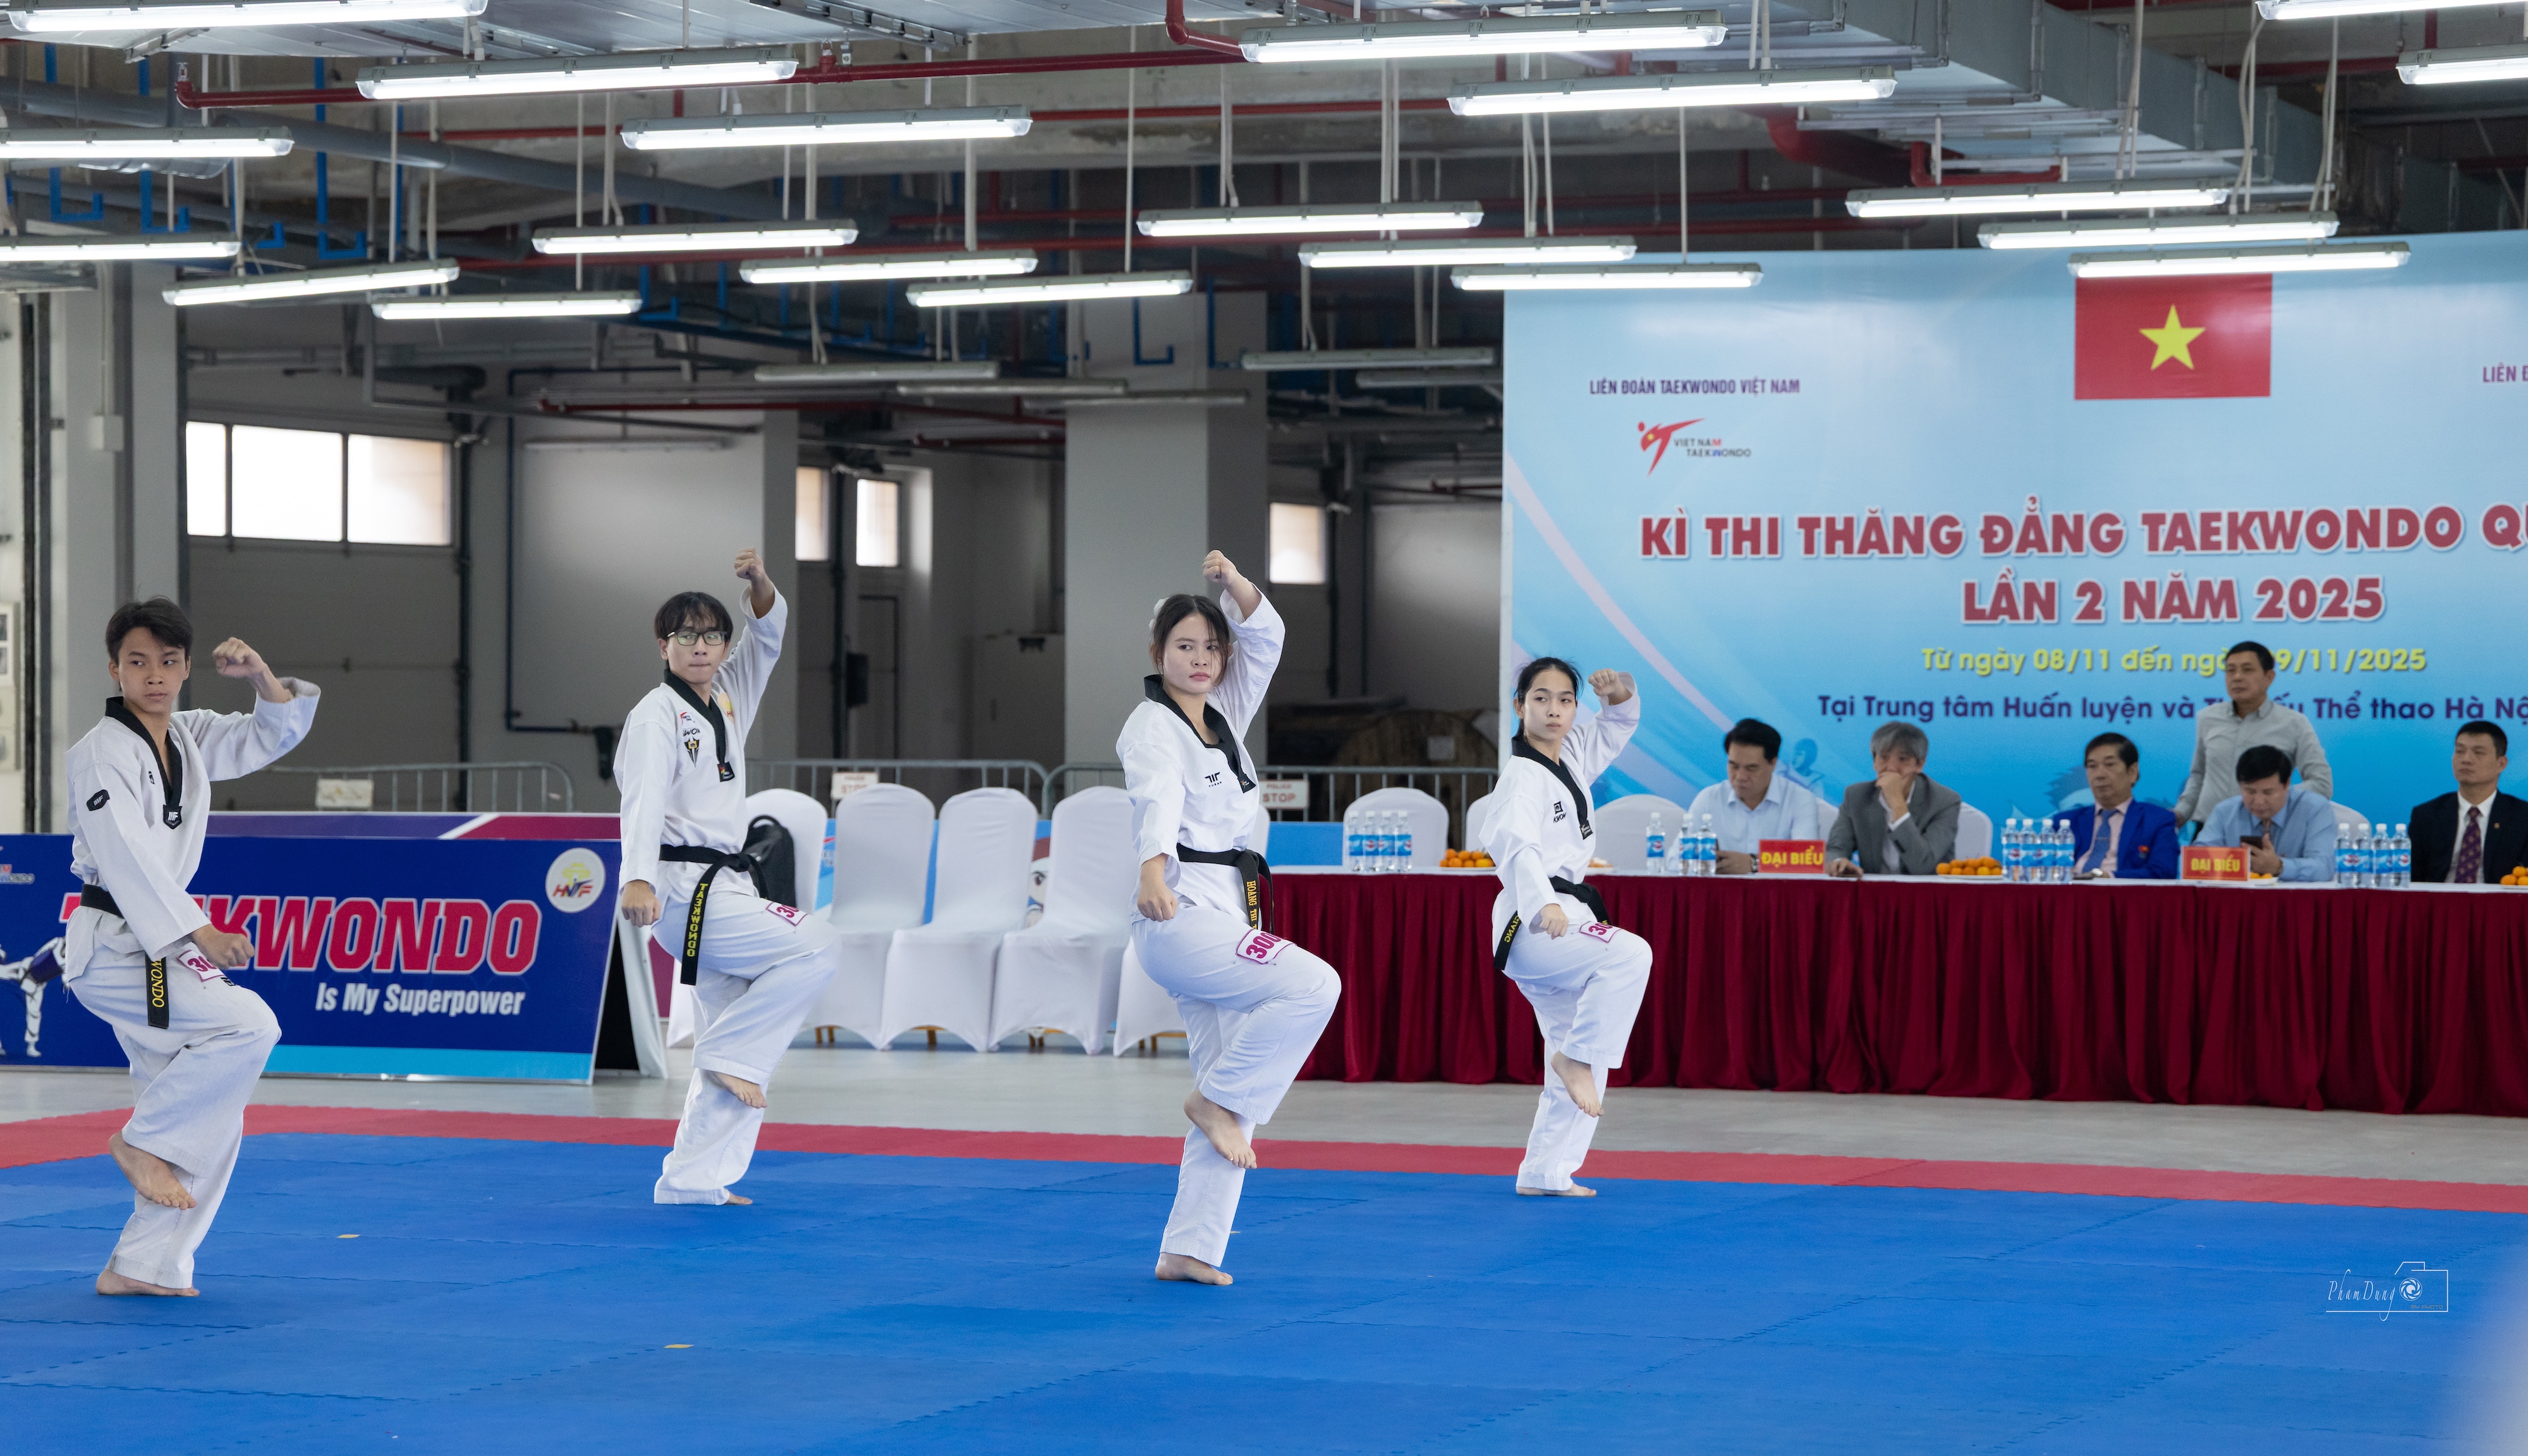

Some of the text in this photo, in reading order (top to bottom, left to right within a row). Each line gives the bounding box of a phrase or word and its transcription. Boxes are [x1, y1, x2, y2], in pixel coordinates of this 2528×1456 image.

[2482, 361, 2517, 382] LIÊN
[1589, 376, 1800, 396] LIÊN ĐOÀN TAEKWONDO VIỆT NAM
[1687, 449, 1751, 457] TAEKWONDO
[1641, 507, 1687, 555] KÌ
[1705, 516, 1779, 555] THI
[1797, 507, 1964, 555] THĂNG
[1979, 495, 2124, 554] ĐẲNG
[2141, 506, 2462, 552] TAEKWONDO
[1964, 567, 2383, 621] LẦN 2 NĂM 2025
[1922, 647, 1953, 670] Từ
[1960, 647, 2026, 676] ngày
[2033, 648, 2110, 674] 08/11
[2122, 645, 2173, 671] đến
[2270, 648, 2426, 674] 9/11/2025
[1818, 696, 1855, 722] Tại
[1864, 696, 1934, 722] Trung
[1943, 695, 1994, 717] tâm
[2003, 691, 2072, 719] Huấn
[2082, 695, 2152, 724] luyện
[2162, 696, 2195, 719] và
[2313, 690, 2361, 719] Thể
[2371, 697, 2435, 719] thao
[2445, 696, 2484, 719] Hà
[1263, 792, 1296, 803] STOP
[1761, 845, 1824, 868] ĐẠI BIỂU
[1246, 880, 1258, 906] HOANG
[1246, 932, 1281, 959] 300
[315, 983, 525, 1017] Is My Superpower
